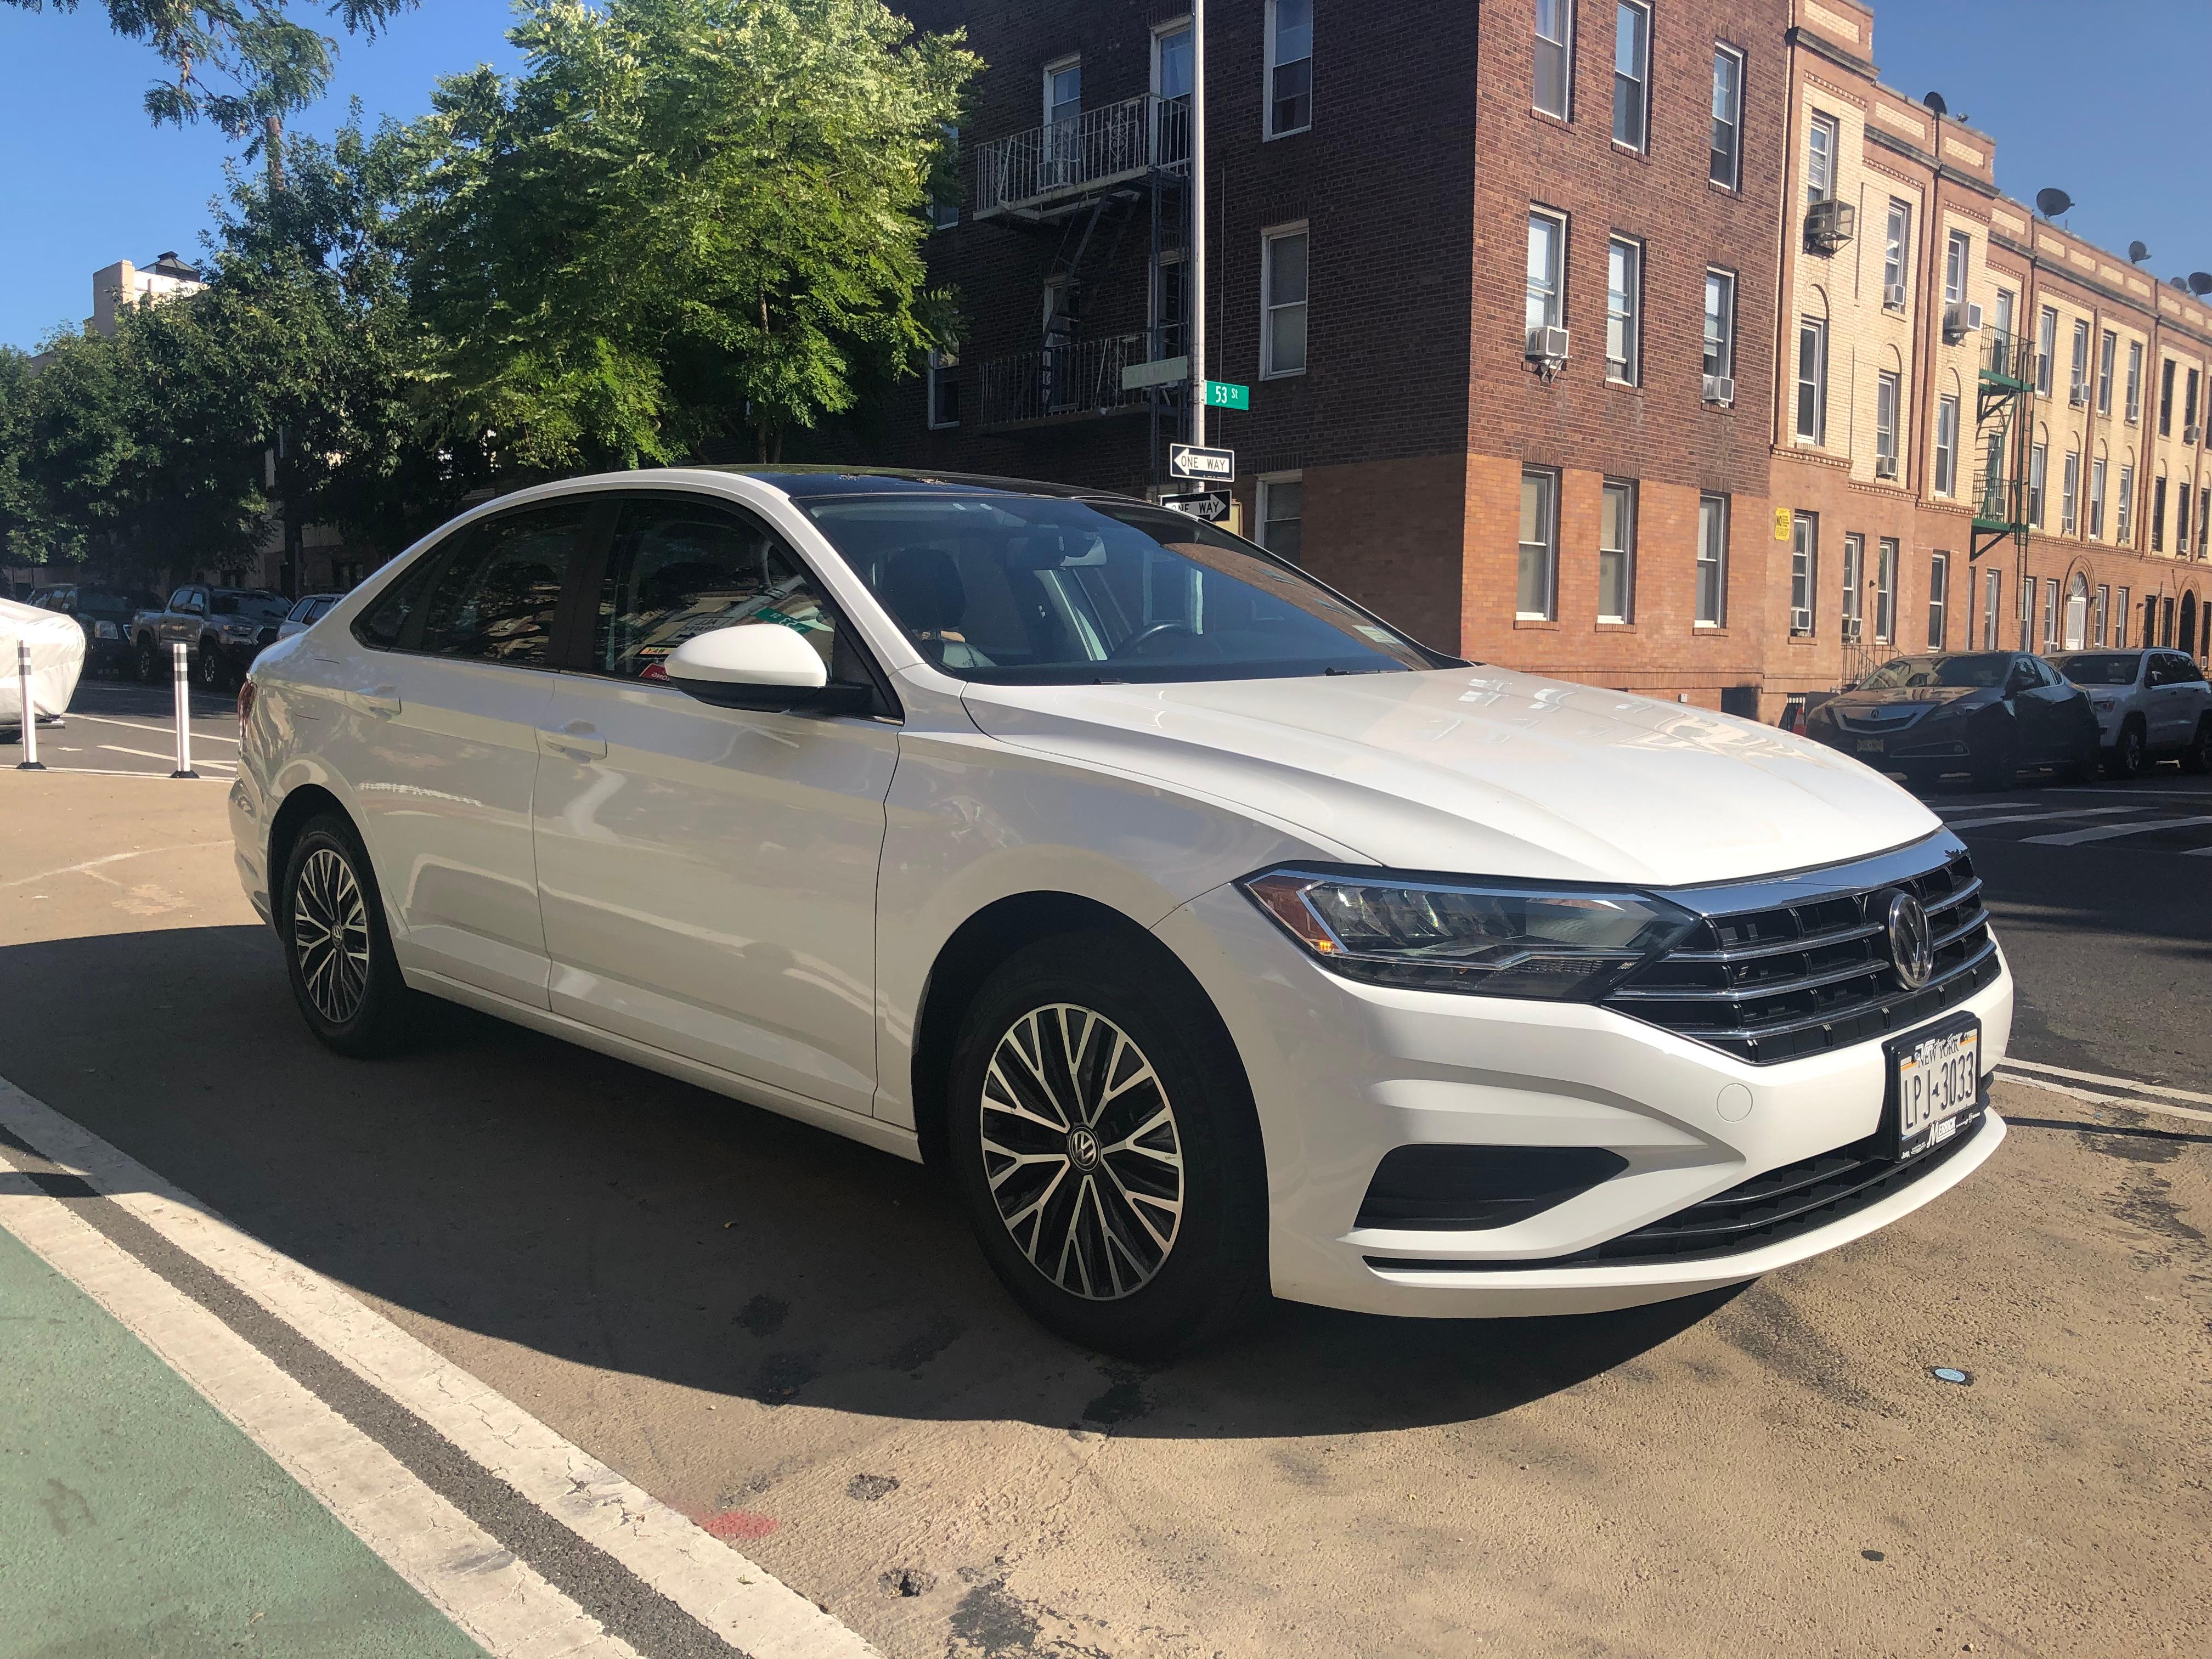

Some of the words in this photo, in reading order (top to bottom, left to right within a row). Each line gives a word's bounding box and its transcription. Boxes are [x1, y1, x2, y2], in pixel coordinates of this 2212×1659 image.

[1215, 385, 1227, 404] 53
[1231, 387, 1238, 399] St
[1181, 455, 1198, 469] ONE
[1207, 458, 1226, 471] WAY
[1199, 501, 1219, 514] WAY
[1927, 1116, 1956, 1148] MERRICK
